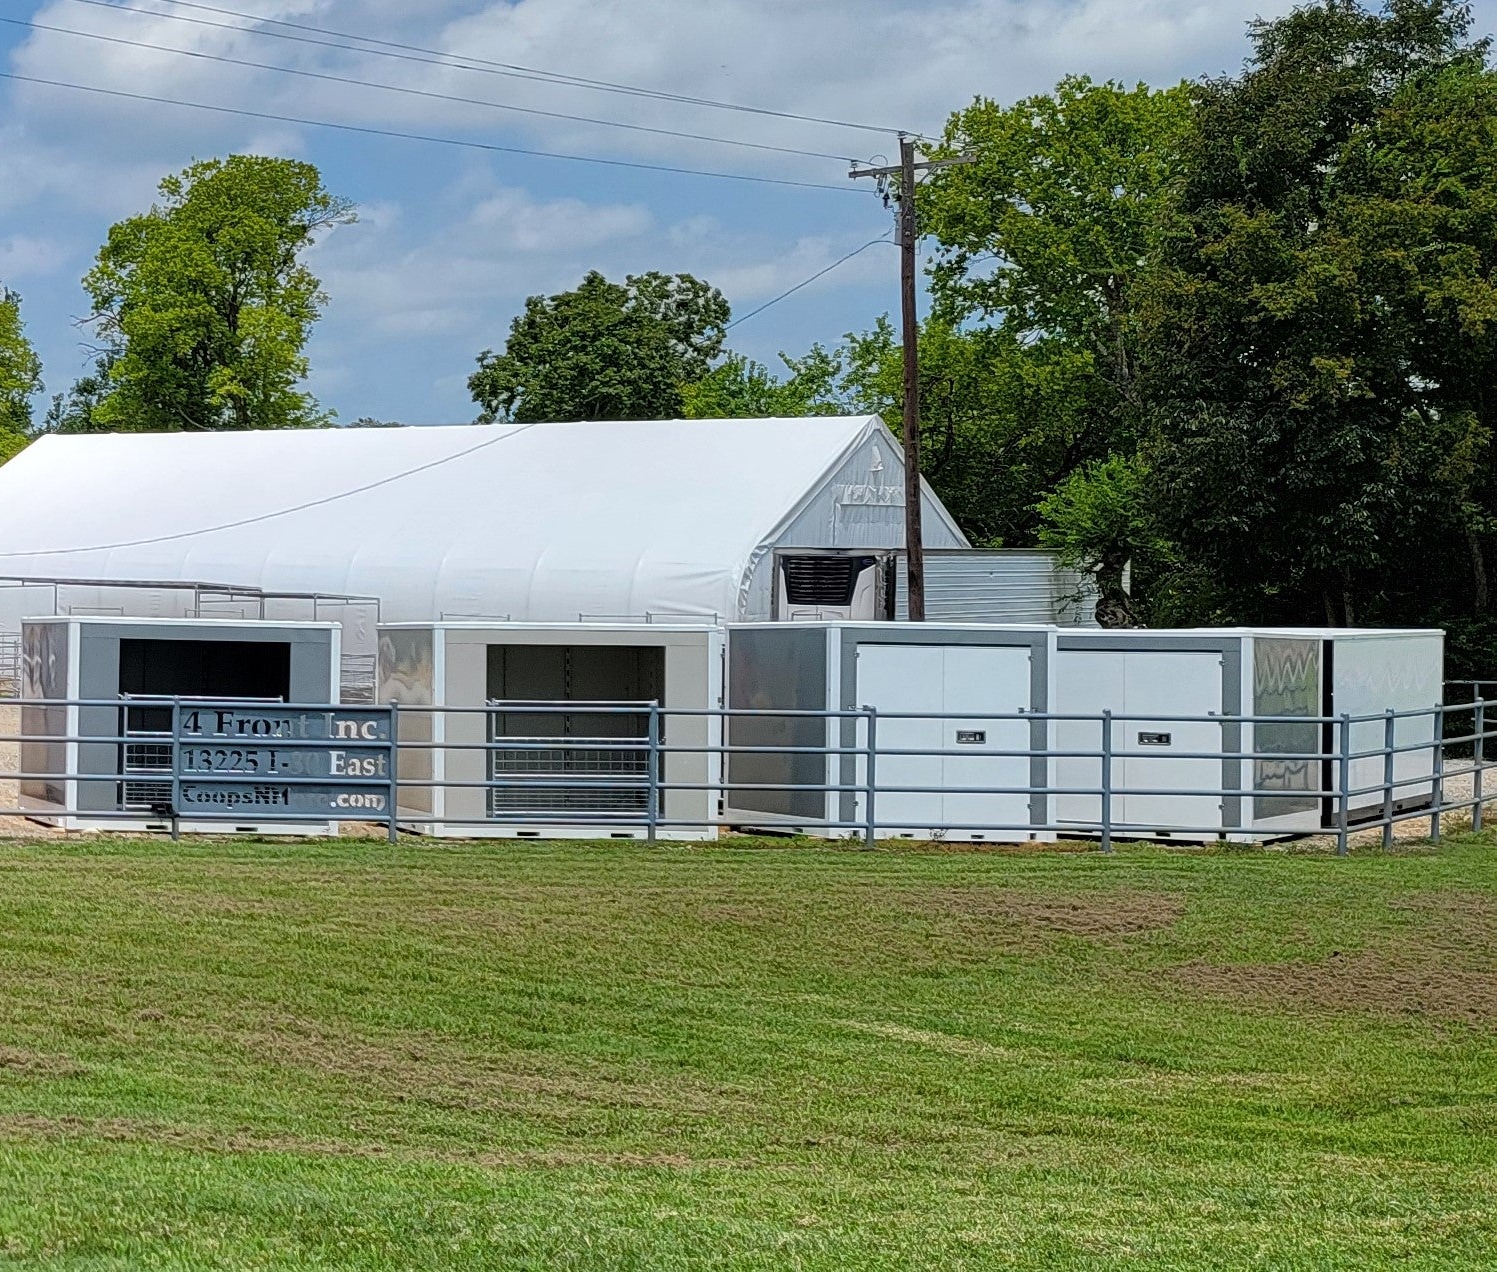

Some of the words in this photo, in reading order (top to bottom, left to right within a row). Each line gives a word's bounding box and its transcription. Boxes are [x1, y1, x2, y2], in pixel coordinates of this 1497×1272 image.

[183, 711, 202, 736] 4
[213, 711, 309, 738] Front
[322, 712, 387, 739] Inc.
[183, 749, 259, 773] 13225
[329, 750, 387, 776] East
